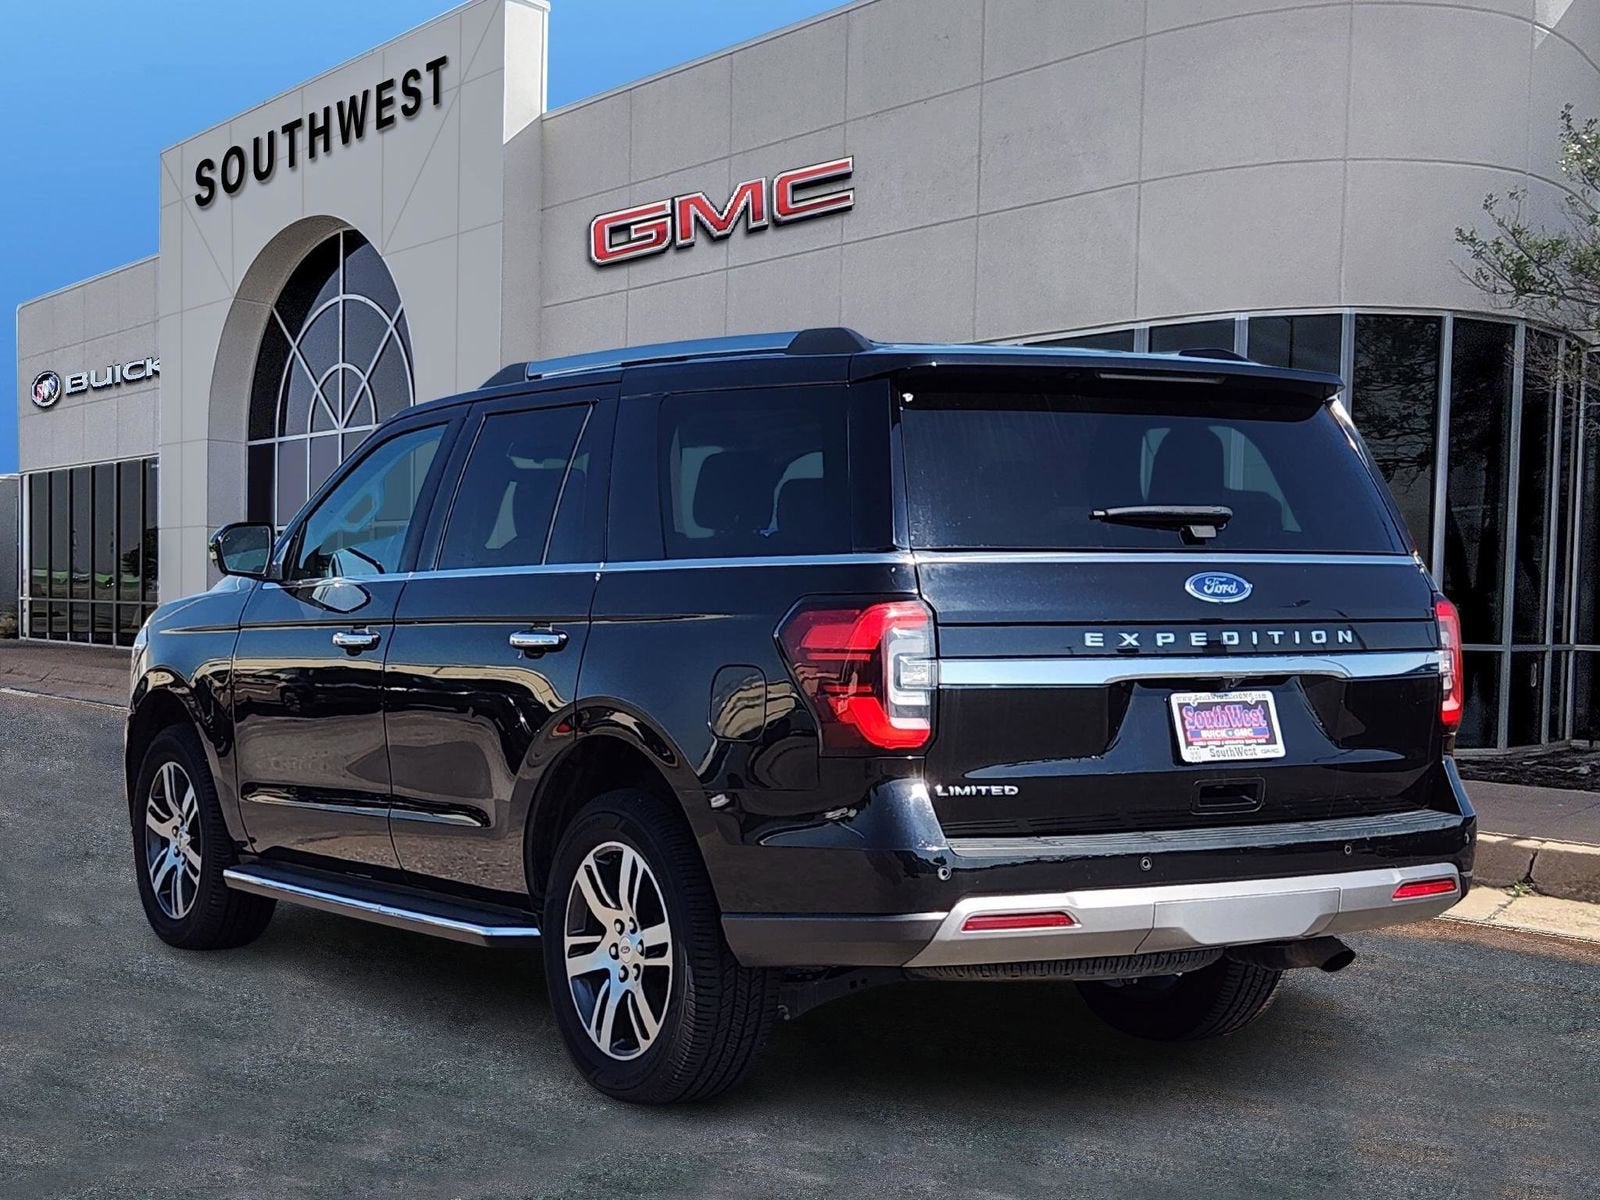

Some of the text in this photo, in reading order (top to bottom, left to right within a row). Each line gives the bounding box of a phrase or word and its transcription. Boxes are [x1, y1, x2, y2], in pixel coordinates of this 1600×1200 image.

[195, 55, 448, 207] SOUTHWEST
[590, 156, 854, 265] GMC
[1203, 577, 1239, 595] Ford
[1084, 630, 1354, 647] EXPEDITION
[935, 784, 1019, 796] LIMITED
